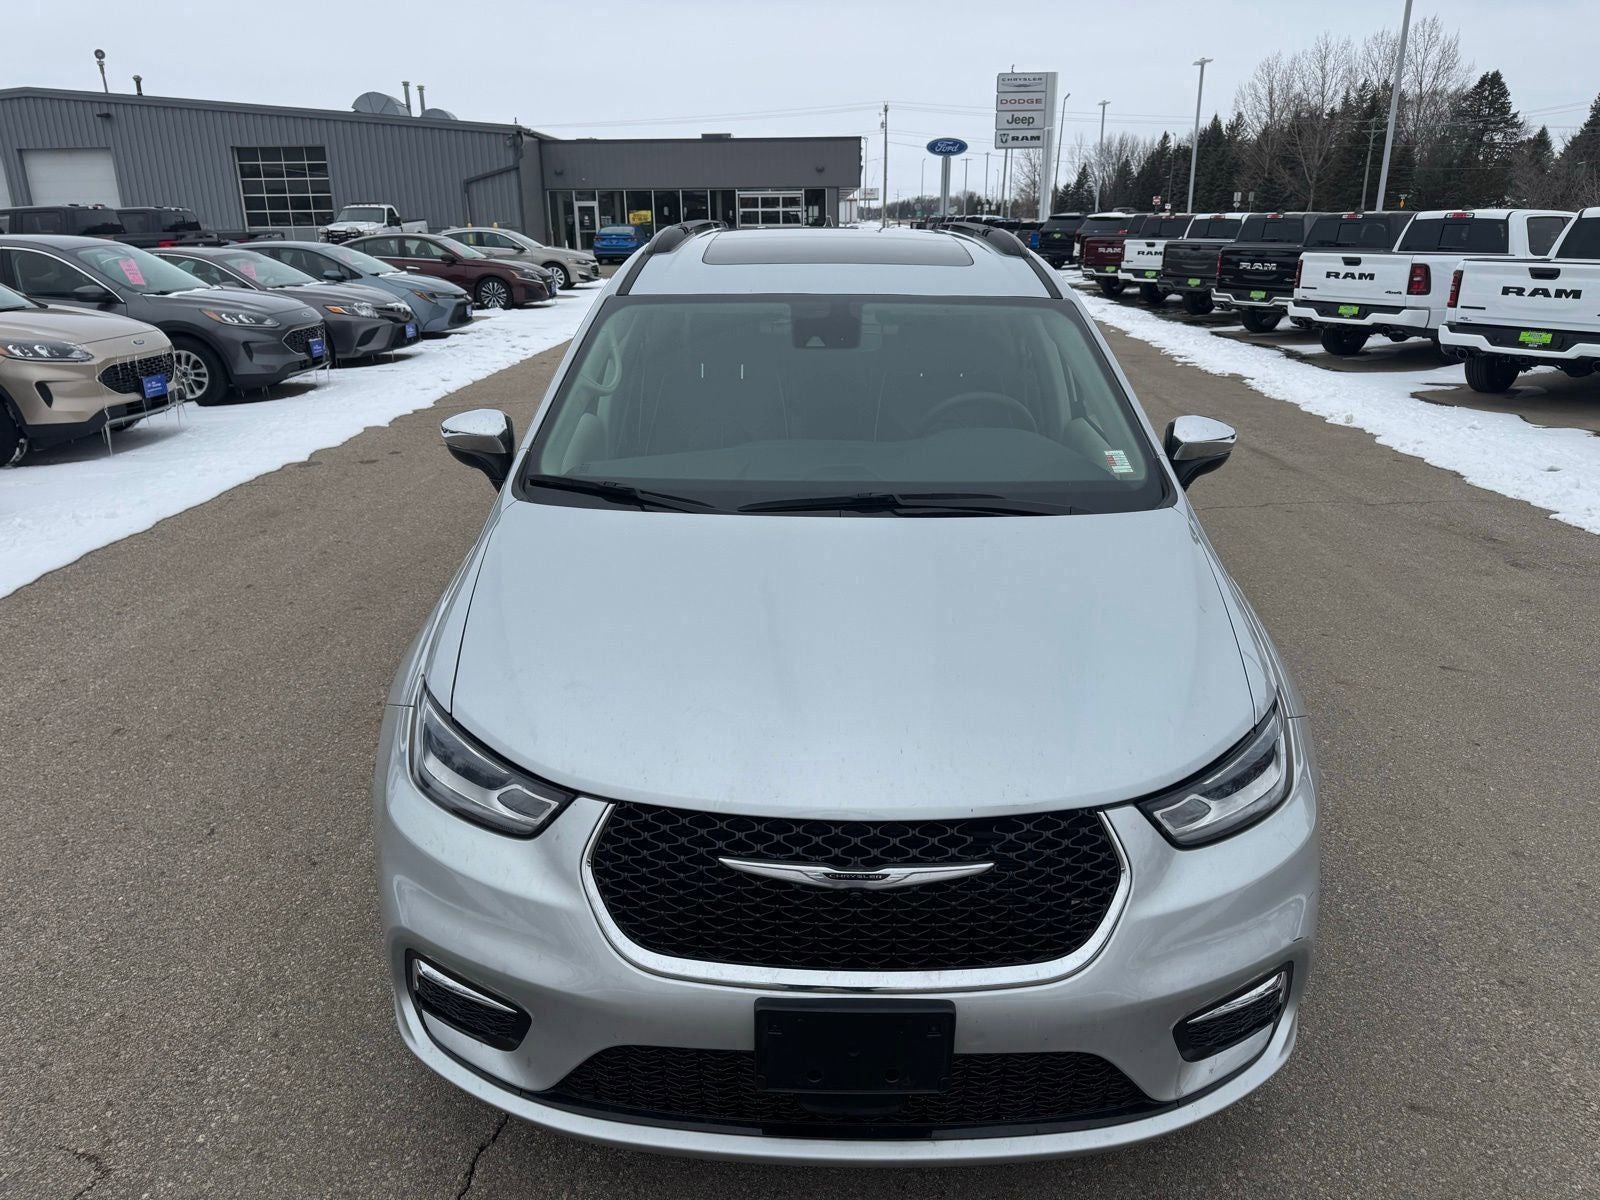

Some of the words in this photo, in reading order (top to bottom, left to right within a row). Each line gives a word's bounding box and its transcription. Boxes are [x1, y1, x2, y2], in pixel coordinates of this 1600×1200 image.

[1006, 113, 1035, 126] Jeep
[935, 141, 960, 152] Ford
[1239, 262, 1277, 270] RAM
[1325, 271, 1375, 281] RAM
[1501, 285, 1582, 300] RAM
